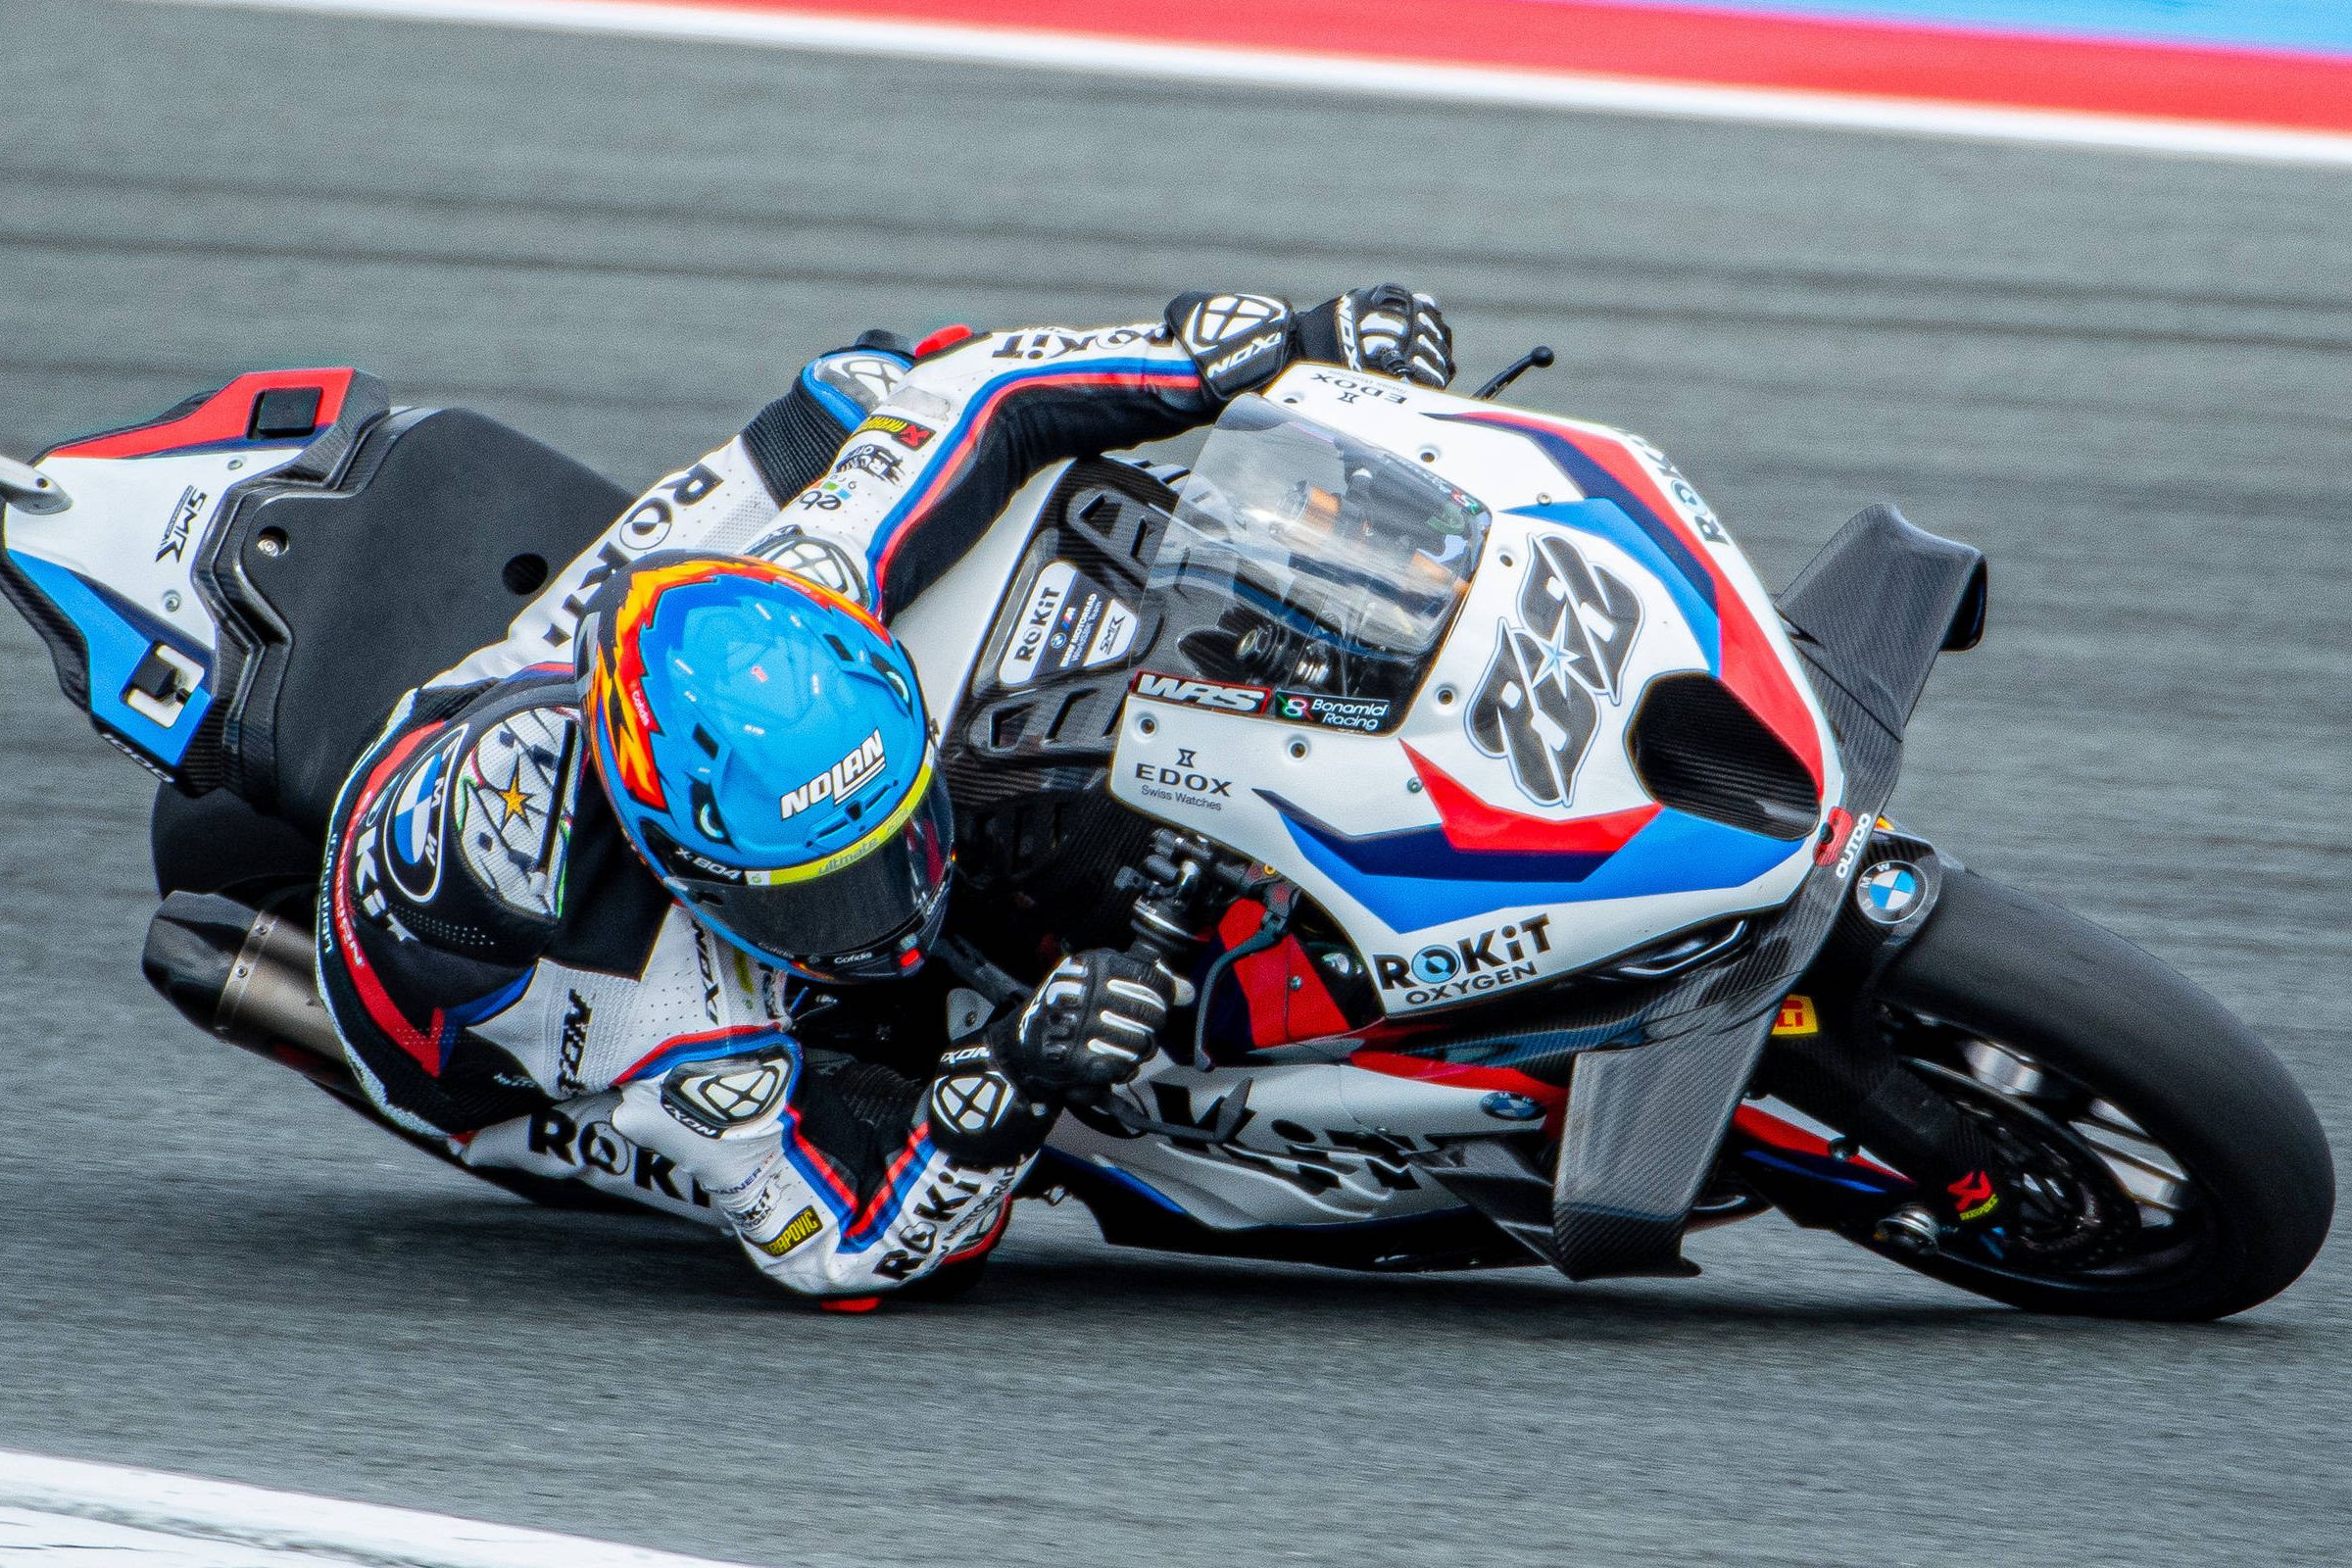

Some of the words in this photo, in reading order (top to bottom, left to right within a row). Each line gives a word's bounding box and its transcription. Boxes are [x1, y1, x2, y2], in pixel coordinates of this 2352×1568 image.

[1137, 674, 1265, 711] WRS
[1322, 712, 1379, 731] Racing
[780, 726, 886, 819] NOLAN
[1135, 763, 1233, 798] EDOX
[1141, 784, 1173, 800] Swiss
[1175, 792, 1222, 811] Watches
[1836, 812, 1873, 880] OUTDO
[1372, 912, 1551, 990] ROKiT
[1405, 960, 1539, 1005] OXYGEN
[940, 1046, 992, 1065] IXON
[664, 1103, 718, 1137] IXON
